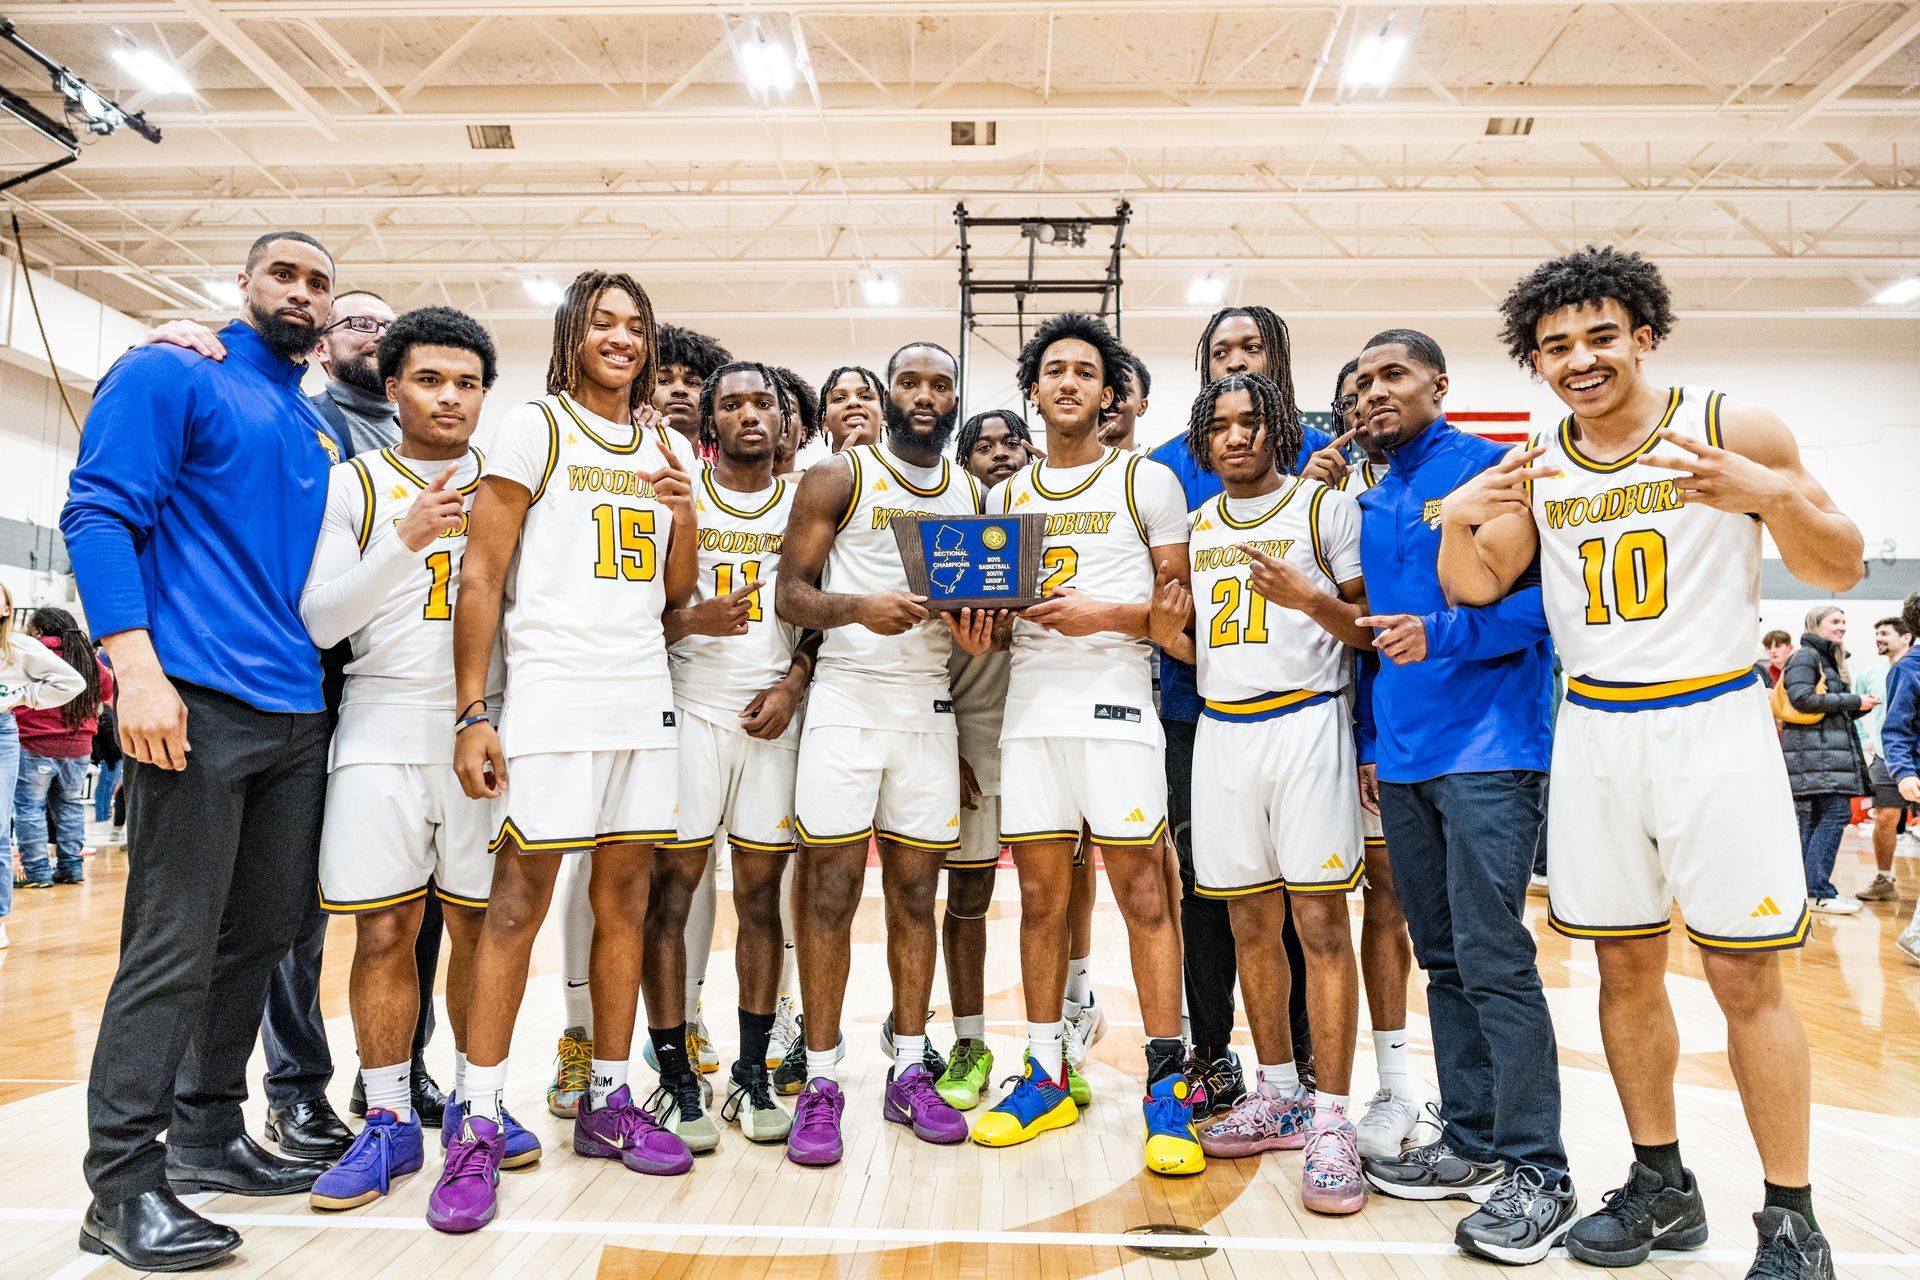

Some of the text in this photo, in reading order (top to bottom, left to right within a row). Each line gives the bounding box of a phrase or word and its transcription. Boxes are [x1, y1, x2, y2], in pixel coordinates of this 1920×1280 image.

[567, 464, 655, 499] WOODBU
[592, 504, 656, 582] 15
[1043, 512, 1116, 537] DBURY
[711, 560, 763, 622] 11
[1041, 546, 1079, 598] 2
[1578, 528, 1668, 625] 10
[1209, 576, 1269, 648] 21
